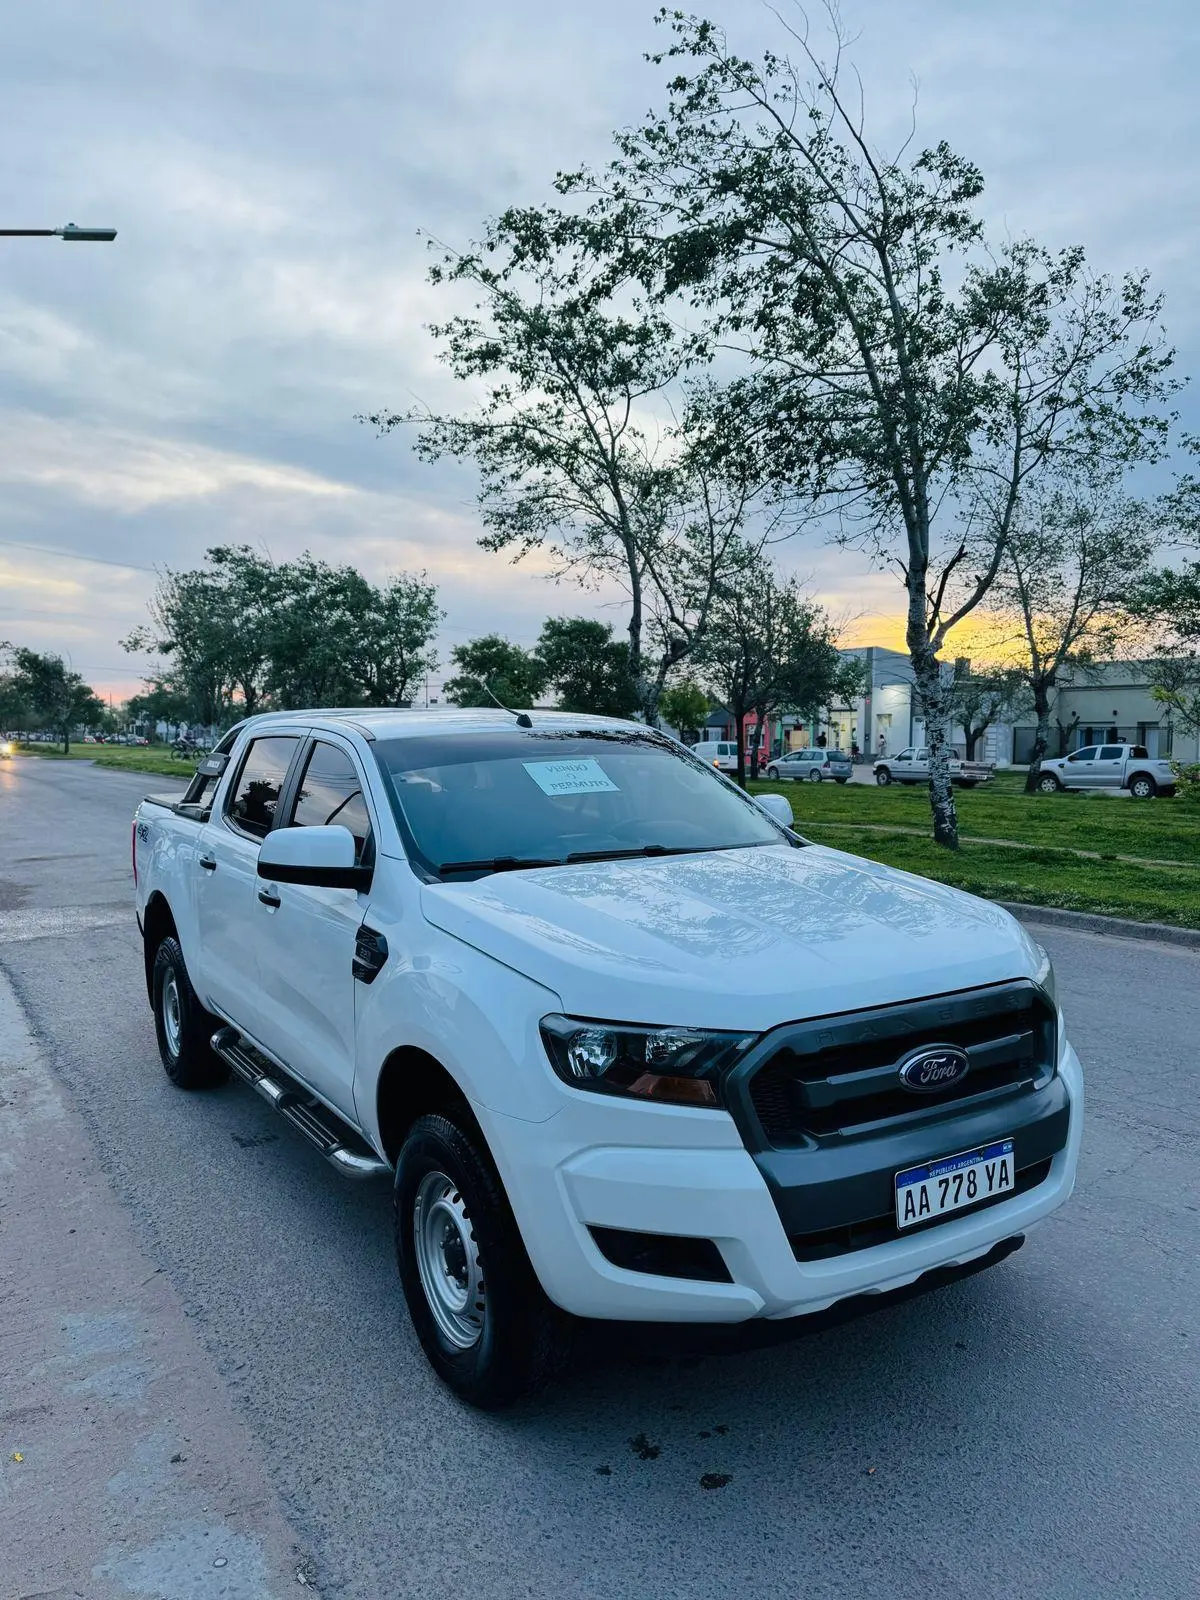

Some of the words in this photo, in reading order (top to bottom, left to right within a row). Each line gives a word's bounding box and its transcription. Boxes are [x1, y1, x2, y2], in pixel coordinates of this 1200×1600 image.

[545, 763, 588, 773] VENDO
[549, 780, 610, 790] PERMUTO
[920, 1057, 957, 1083] Ford
[904, 1184, 931, 1221] AA
[938, 1169, 978, 1208] 778
[984, 1159, 1010, 1191] YA
